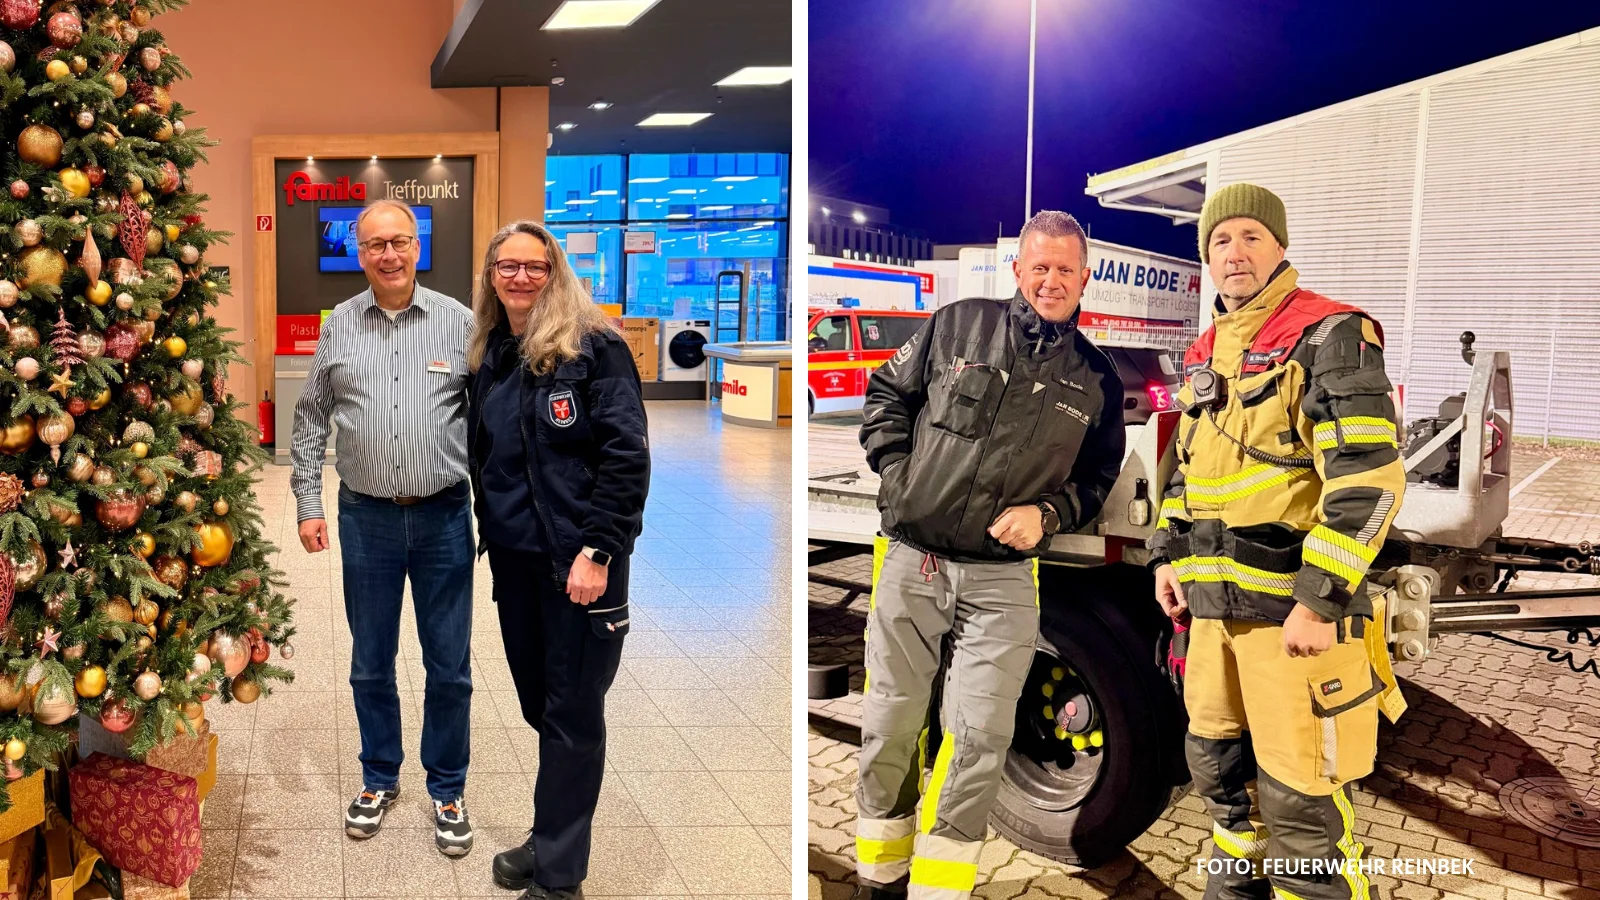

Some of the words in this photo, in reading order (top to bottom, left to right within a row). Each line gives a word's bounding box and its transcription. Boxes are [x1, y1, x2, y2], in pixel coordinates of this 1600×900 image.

[283, 170, 366, 207] famila
[384, 180, 459, 204] Treffpunkt
[1092, 258, 1130, 284] JAN
[1134, 265, 1180, 292] BODE
[1091, 288, 1121, 303] UMZUG
[1129, 293, 1169, 309] TRANSPORT
[1174, 300, 1199, 313] LOGISTI
[290, 323, 320, 336] Plasti
[722, 374, 747, 397] amila
[1055, 401, 1068, 410] JAN
[1067, 406, 1083, 418] BODE
